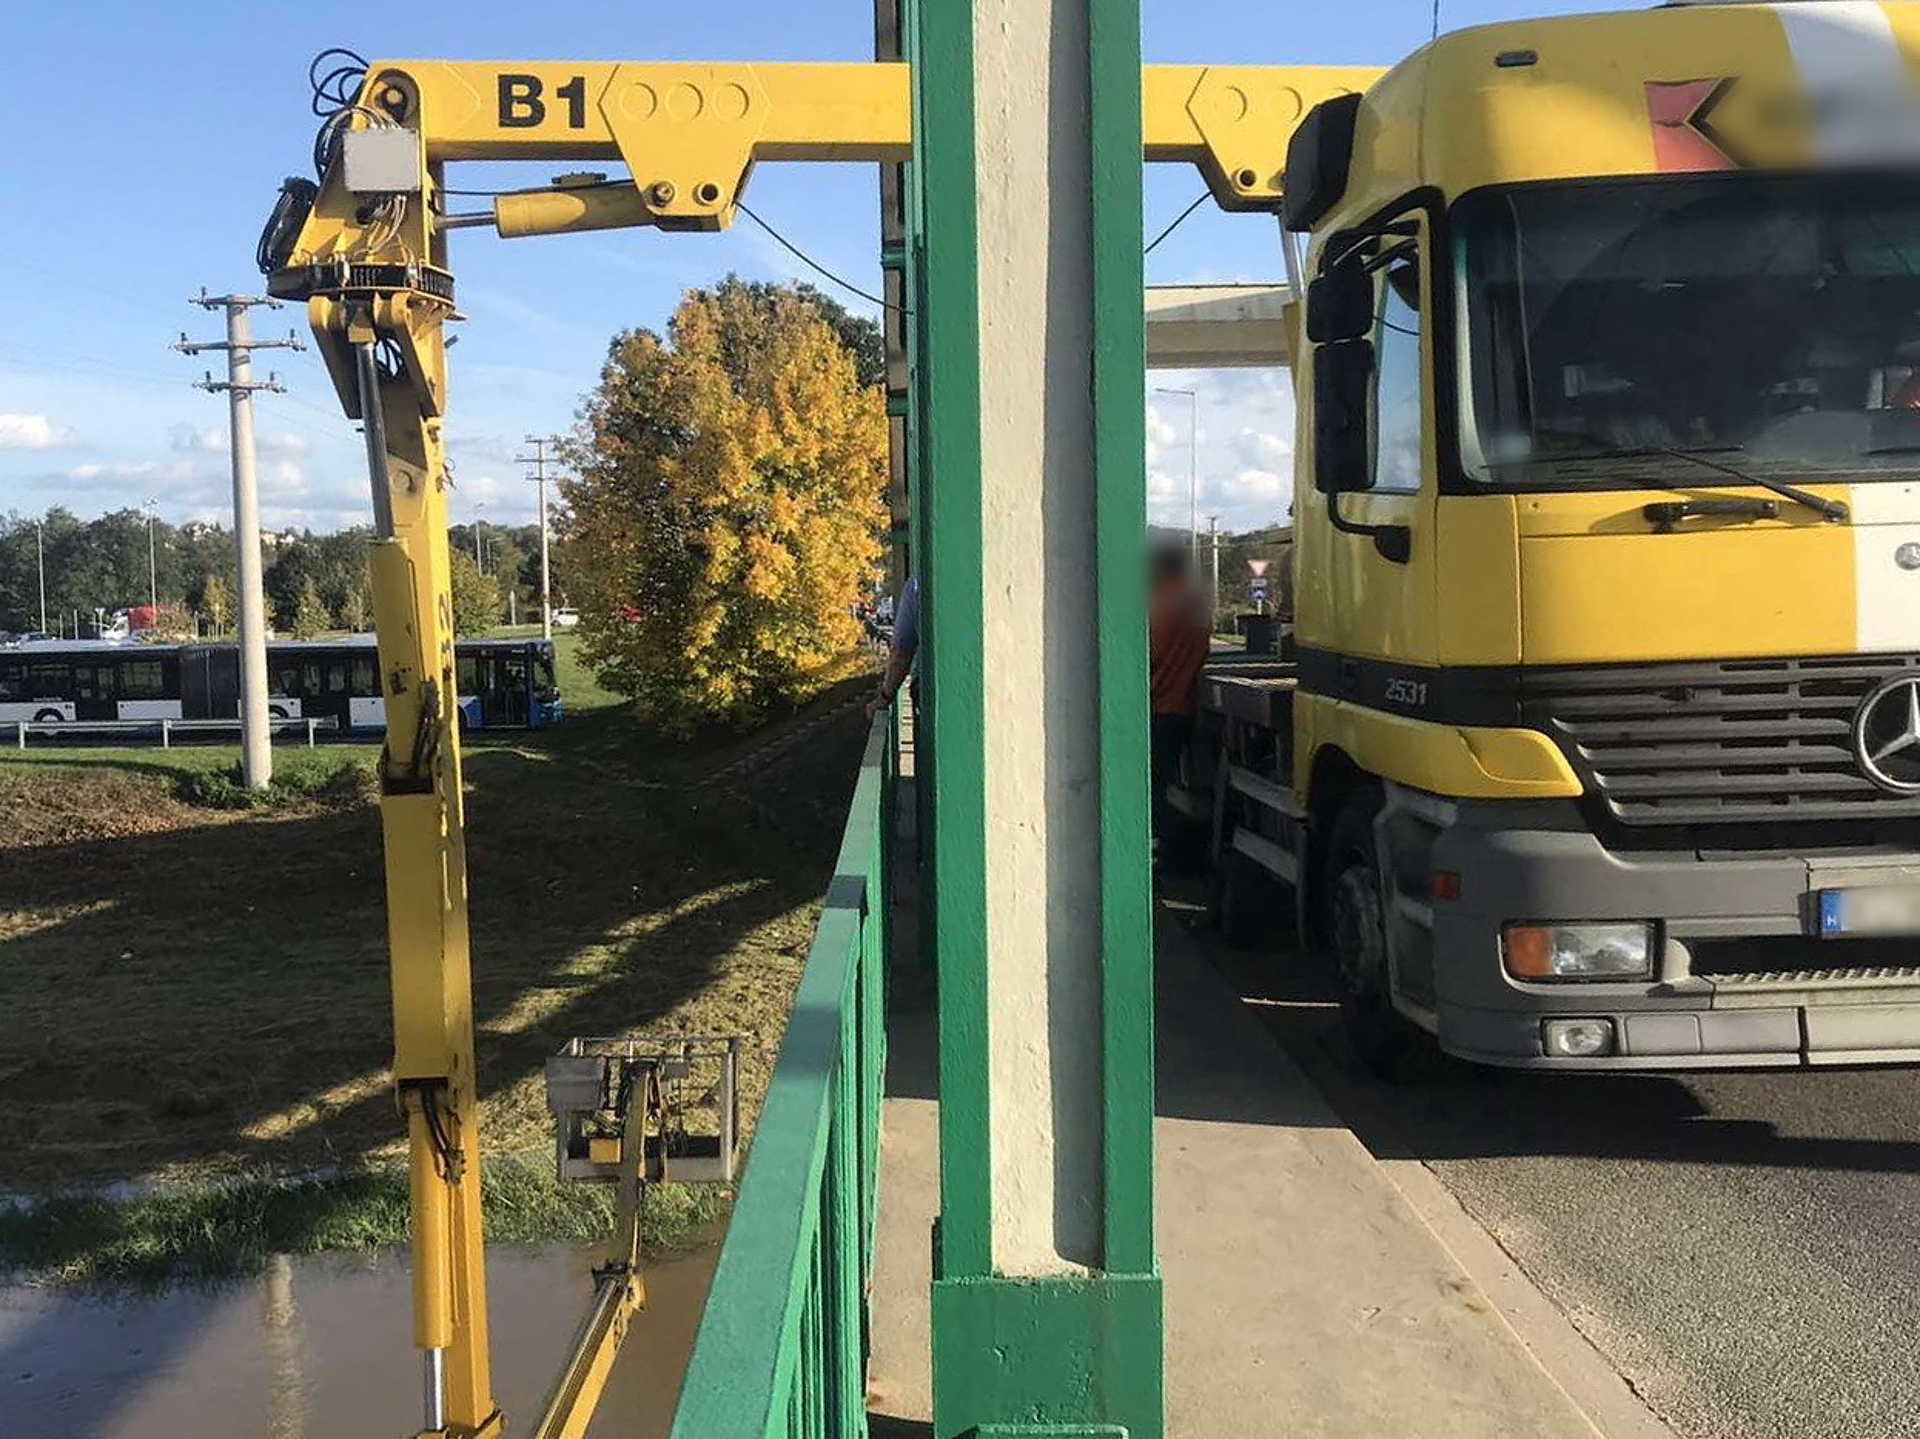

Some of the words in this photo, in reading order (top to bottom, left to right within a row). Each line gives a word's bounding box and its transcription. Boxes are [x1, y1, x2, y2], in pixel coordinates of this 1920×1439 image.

[497, 74, 585, 129] B1
[1385, 678, 1428, 705] 2531
[1826, 914, 1838, 927] H
